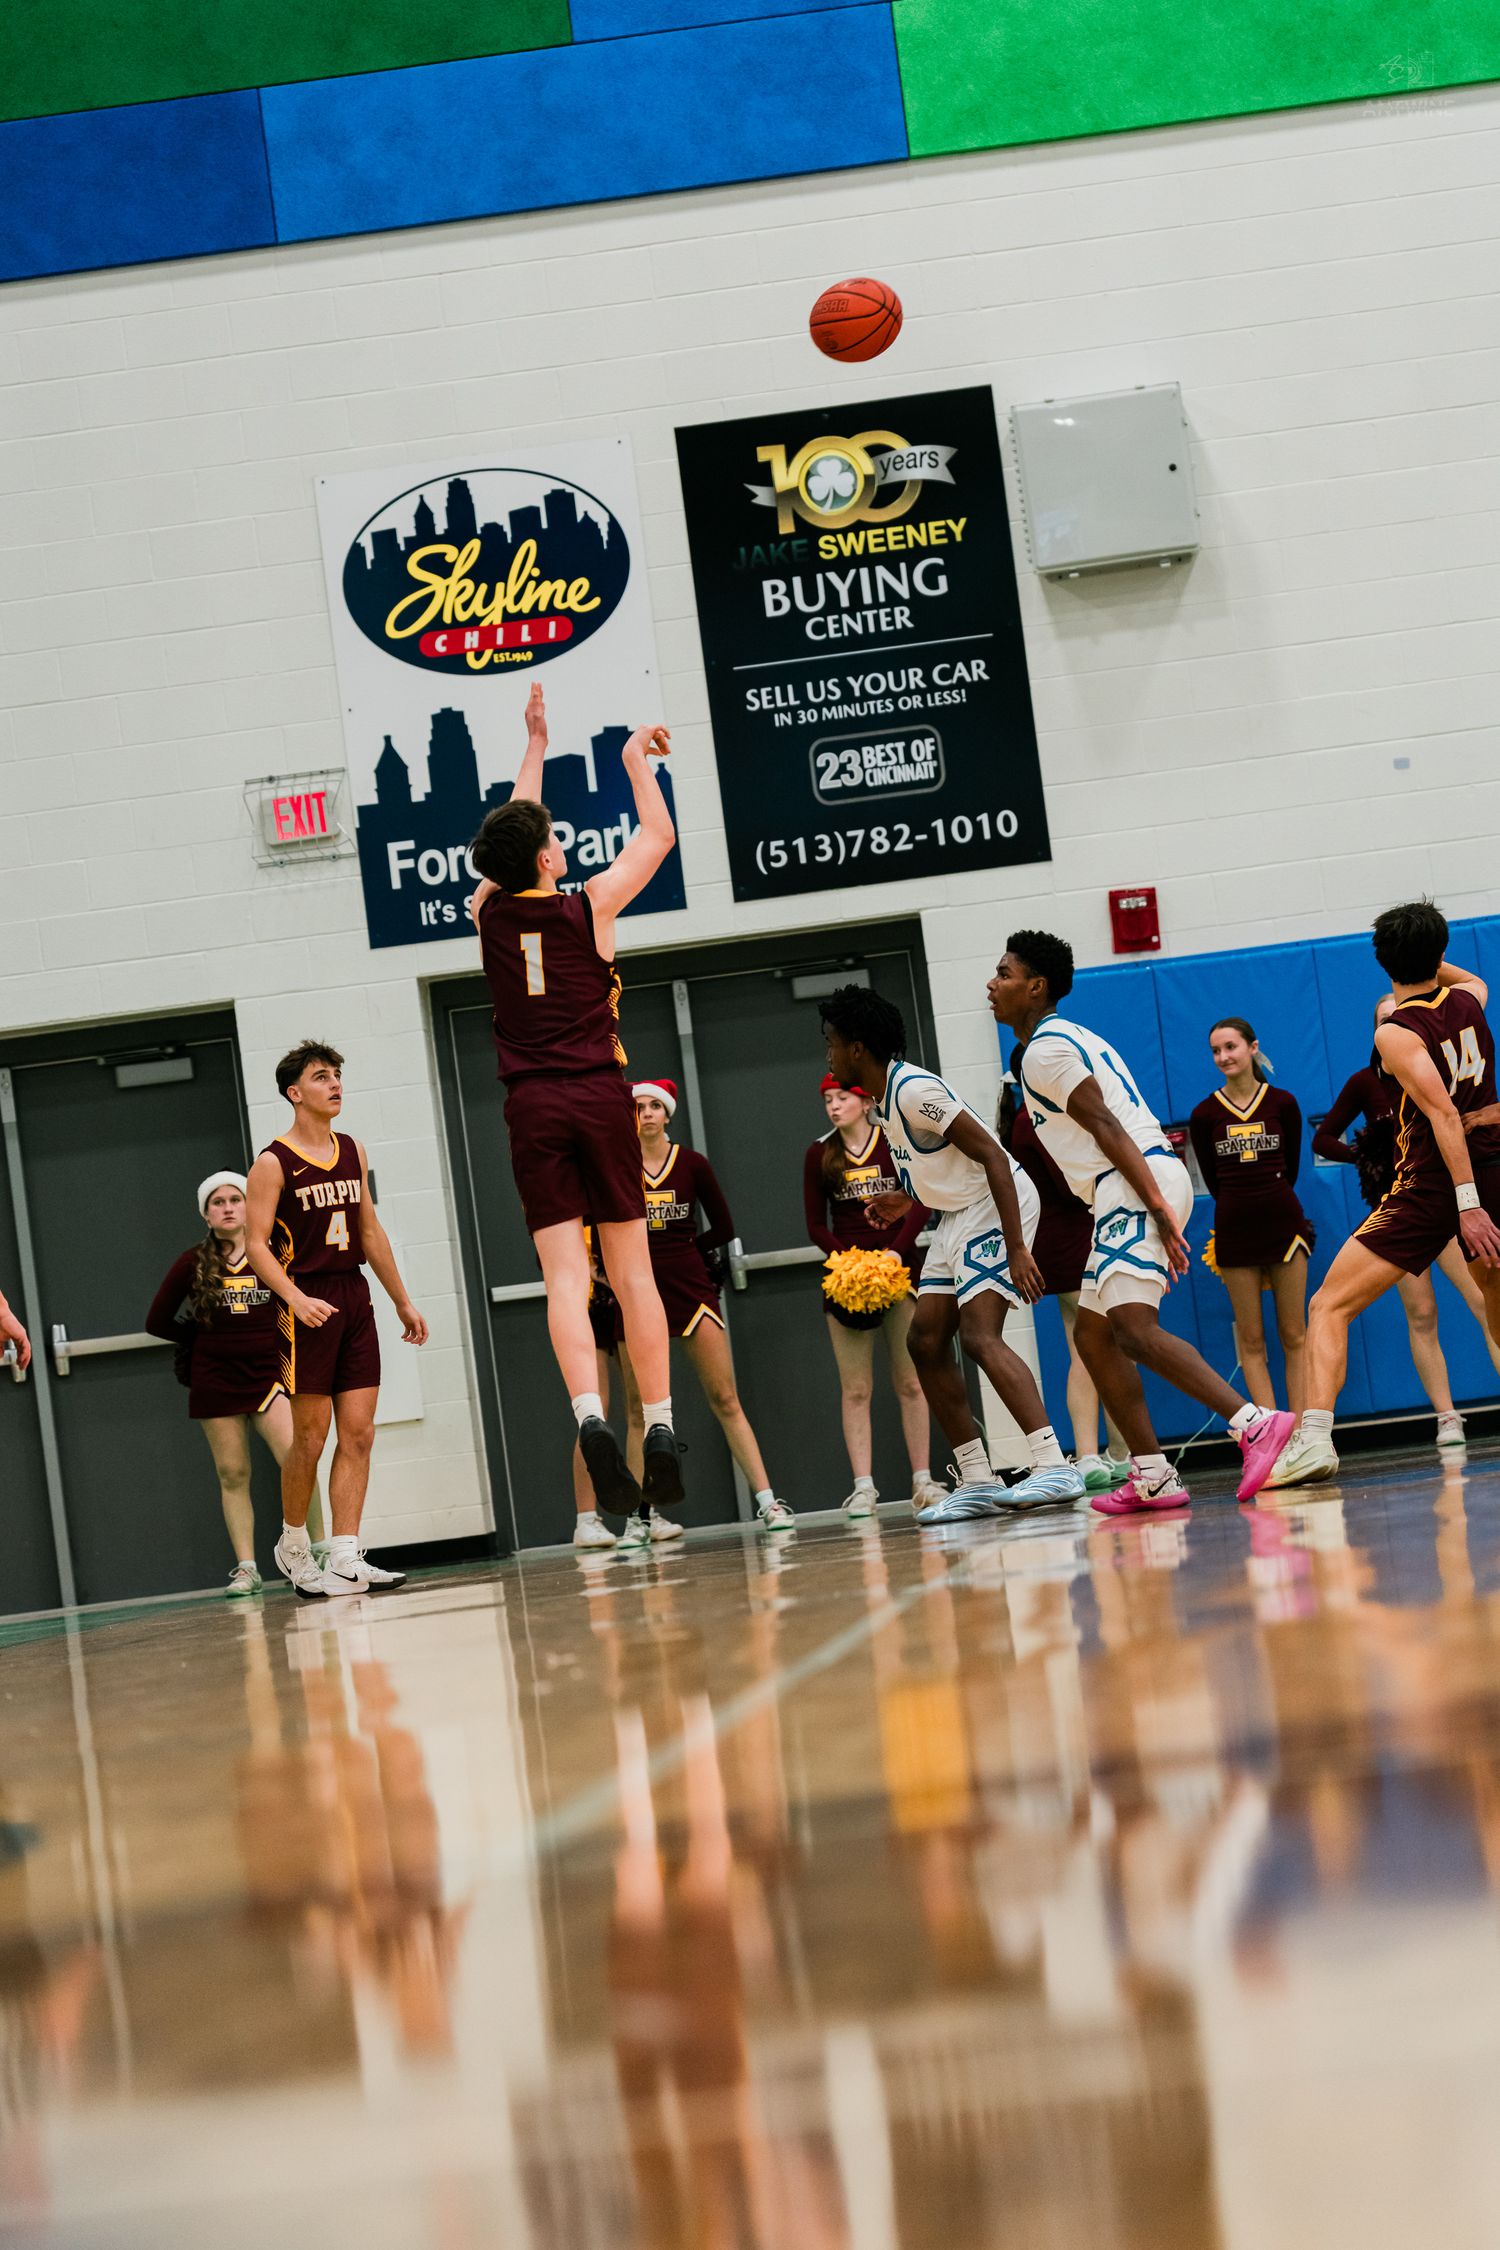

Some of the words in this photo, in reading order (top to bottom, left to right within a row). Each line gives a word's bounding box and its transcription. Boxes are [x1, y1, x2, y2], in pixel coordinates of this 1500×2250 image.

[756, 430, 923, 534] 100
[879, 450, 940, 480] years
[734, 538, 809, 570] JAKE
[818, 518, 967, 560] SWEENEY
[385, 538, 601, 670] Skyline
[762, 558, 949, 618] BUYING
[435, 620, 557, 653] CHILI
[806, 606, 915, 641] CENTER
[746, 684, 801, 712] SELL
[806, 678, 842, 703] US
[847, 667, 927, 698] YOUR
[932, 659, 990, 686] CAR
[774, 711, 793, 728] IN
[797, 708, 819, 725] 30
[822, 699, 895, 721] MINUTES
[898, 694, 924, 711] OR
[927, 688, 967, 708] LESS!
[816, 749, 864, 790] 23
[861, 741, 906, 769] BEST
[911, 737, 936, 762] OF
[272, 791, 327, 841] EXIT
[755, 810, 1019, 875] (513)782-1010
[419, 899, 458, 926] It's
[520, 932, 546, 996] 1
[1440, 1025, 1486, 1097] 14
[1215, 1135, 1280, 1156] SPARTANS
[325, 1210, 350, 1251] 4
